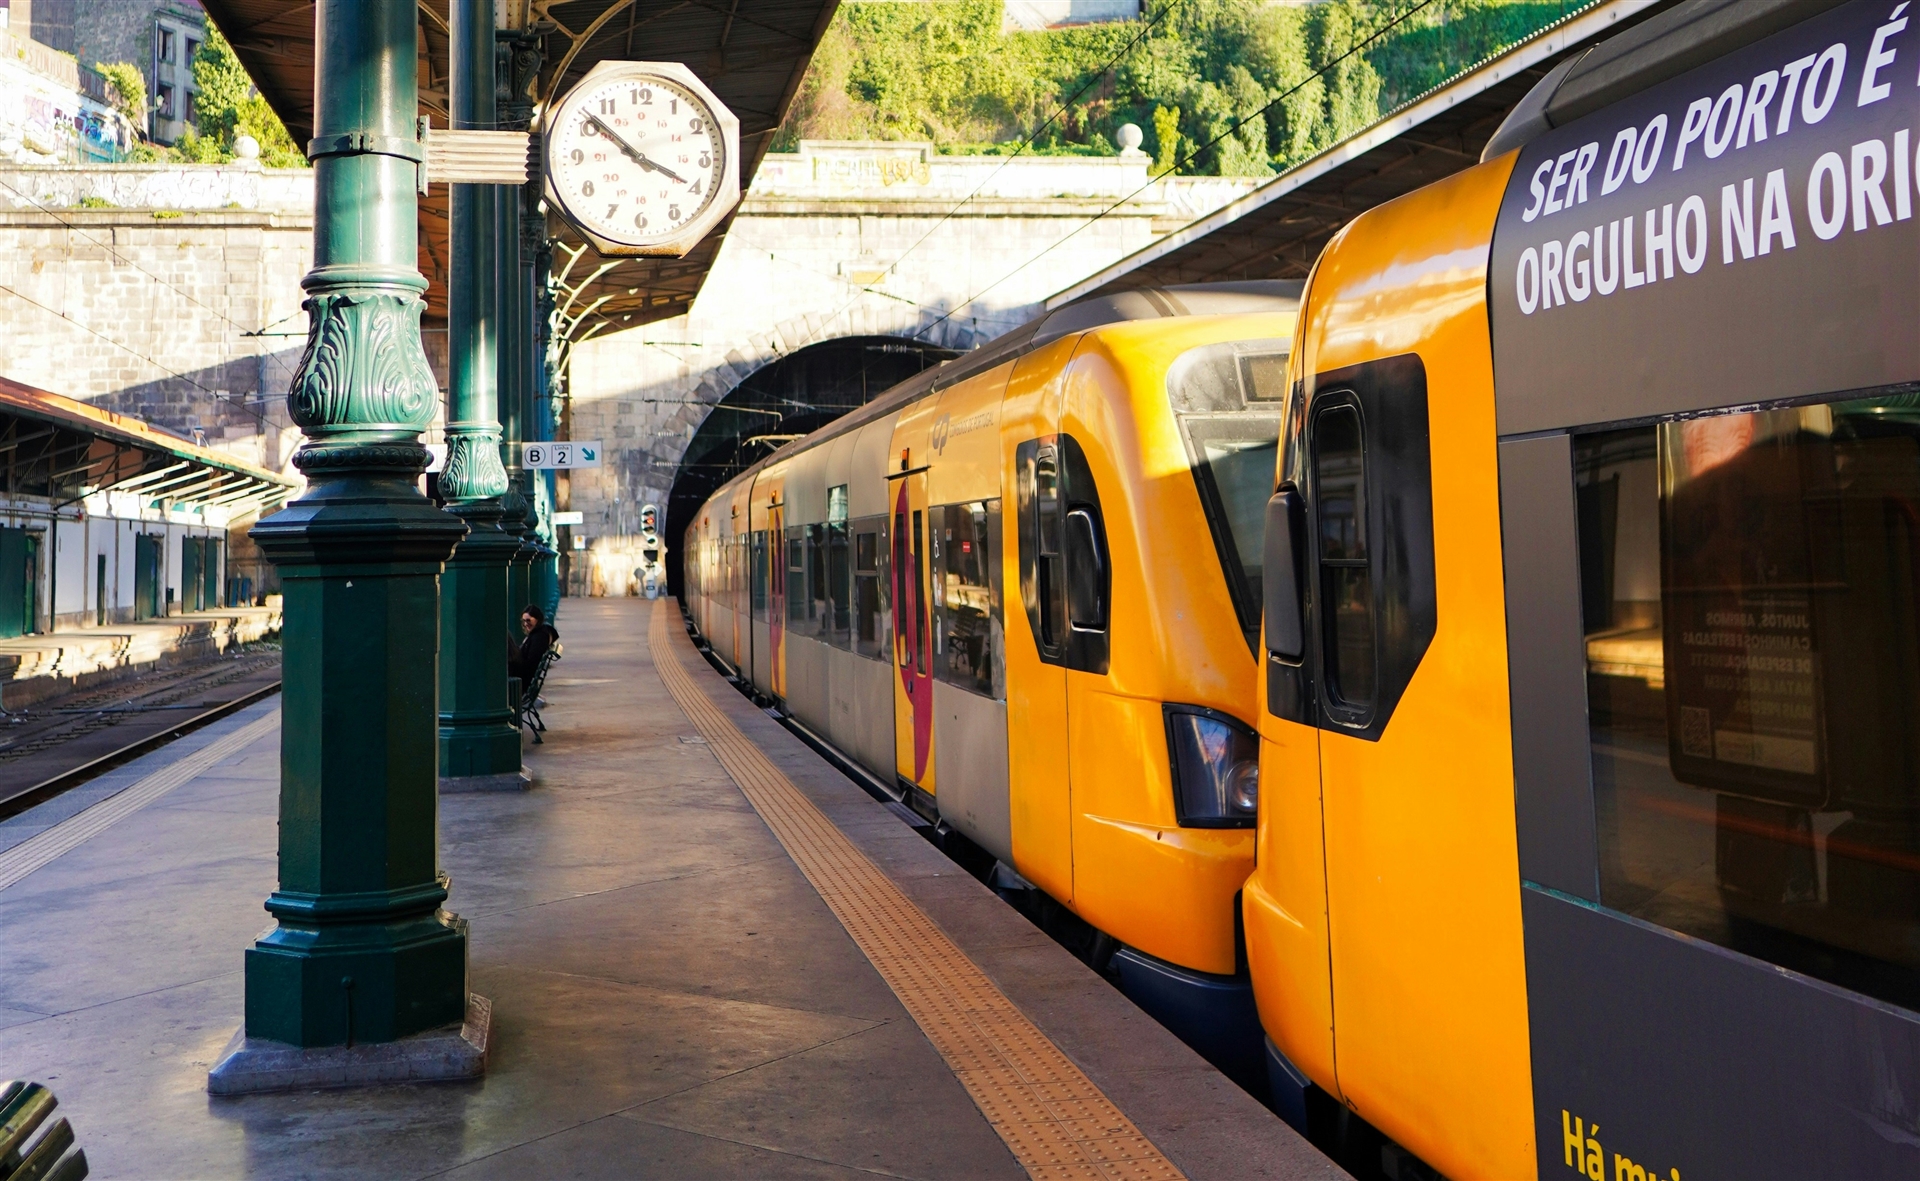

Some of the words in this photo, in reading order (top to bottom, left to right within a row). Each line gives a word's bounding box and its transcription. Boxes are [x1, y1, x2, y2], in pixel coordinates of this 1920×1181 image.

[629, 88, 653, 105] 12
[598, 98, 616, 115] 11
[669, 98, 678, 115] 1
[1522, 141, 1599, 223] SER
[1601, 113, 1668, 196] DO
[1672, 42, 1847, 171] PORTO
[1857, 0, 1911, 108] É
[578, 119, 600, 137] 10
[689, 117, 703, 135] 2
[671, 134, 682, 142] 14
[570, 148, 584, 166] 9
[594, 153, 606, 162] 21
[698, 150, 712, 169] 3
[602, 173, 619, 182] 20
[687, 177, 702, 195] 4
[581, 180, 595, 197] 8
[659, 190, 669, 199] 17
[605, 203, 620, 219] 7
[668, 203, 681, 221] 5
[634, 211, 648, 229] 6
[1516, 195, 1708, 315] ORGULHO
[1721, 168, 1796, 265] NA
[530, 450, 540, 462] B
[558, 451, 566, 464] 2
[1562, 1109, 1605, 1181] Há
